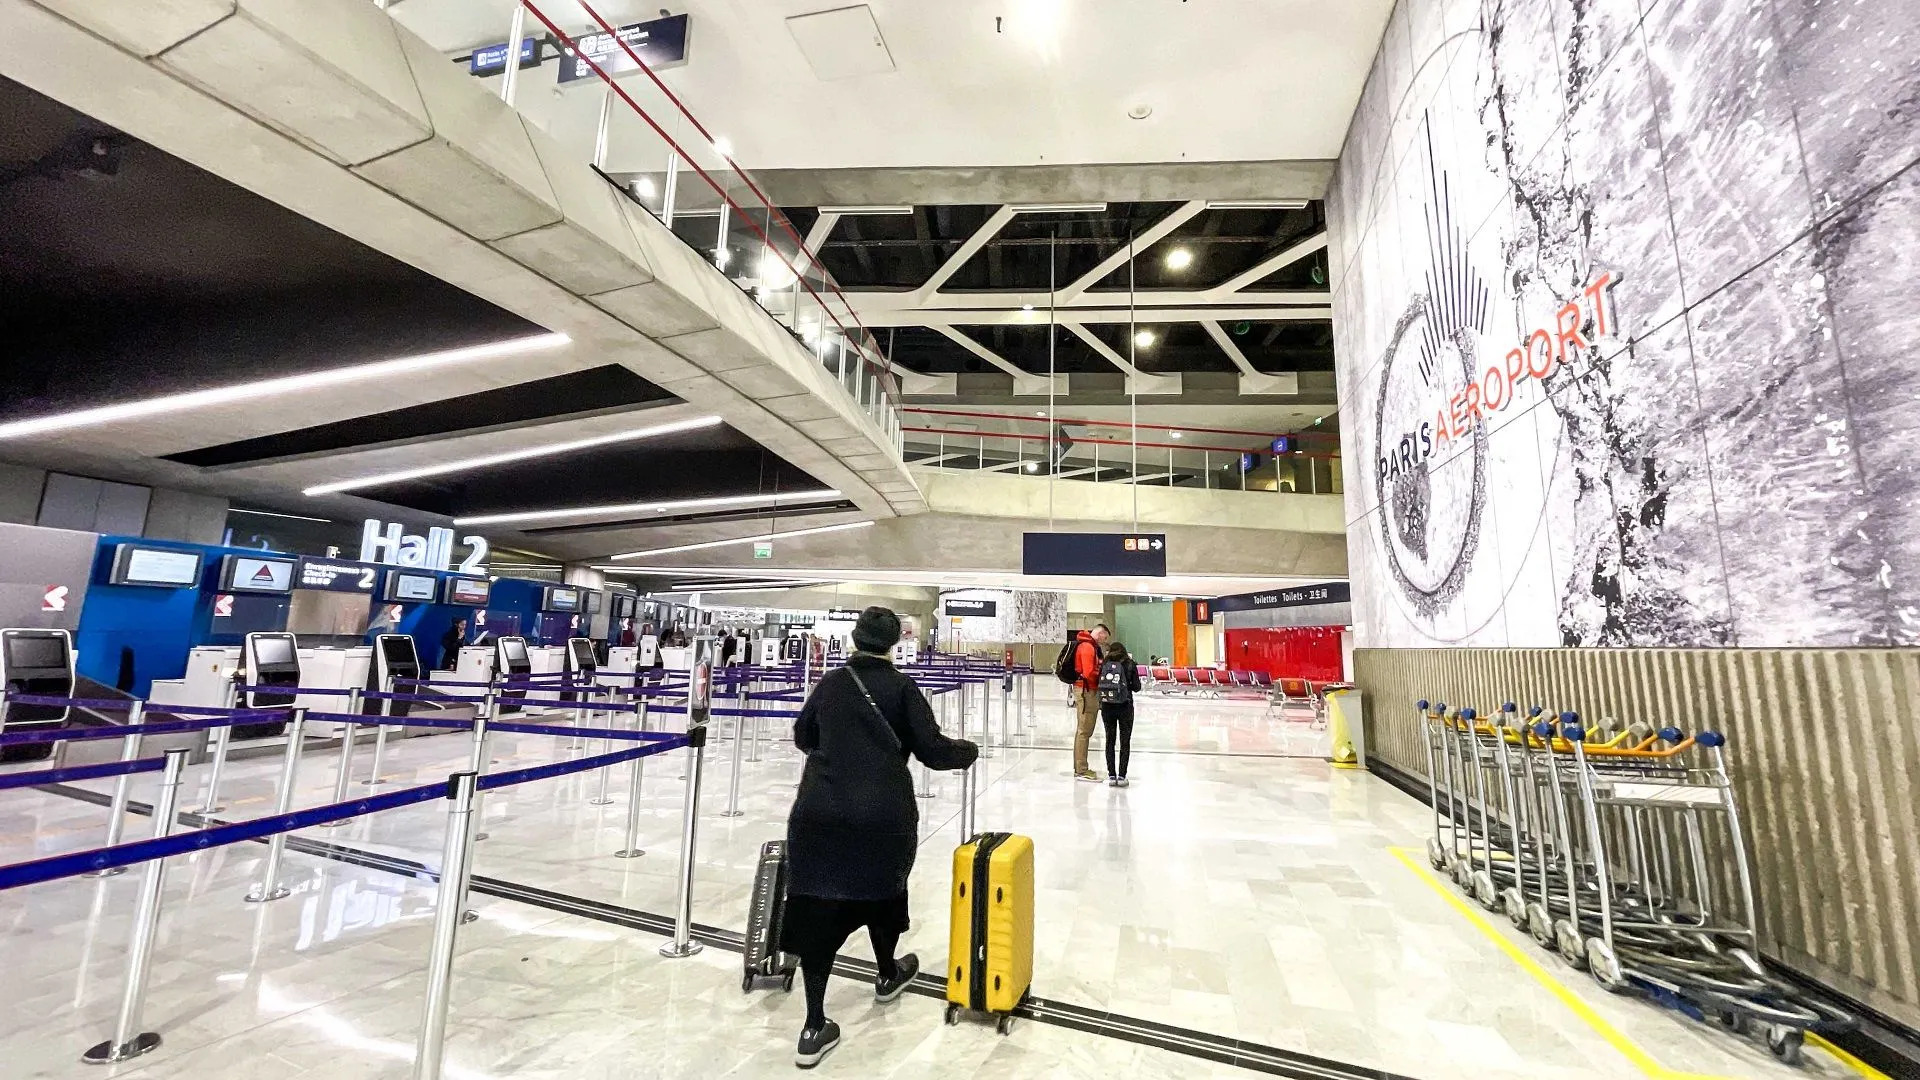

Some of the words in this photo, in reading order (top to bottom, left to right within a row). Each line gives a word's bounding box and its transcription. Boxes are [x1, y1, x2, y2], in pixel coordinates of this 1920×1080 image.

[1379, 421, 1431, 485] PARIS
[360, 519, 454, 570] Hall
[459, 535, 487, 575] 2
[358, 567, 376, 588] 2
[1253, 595, 1278, 605] Toilettes
[1282, 591, 1303, 602] Toilets
